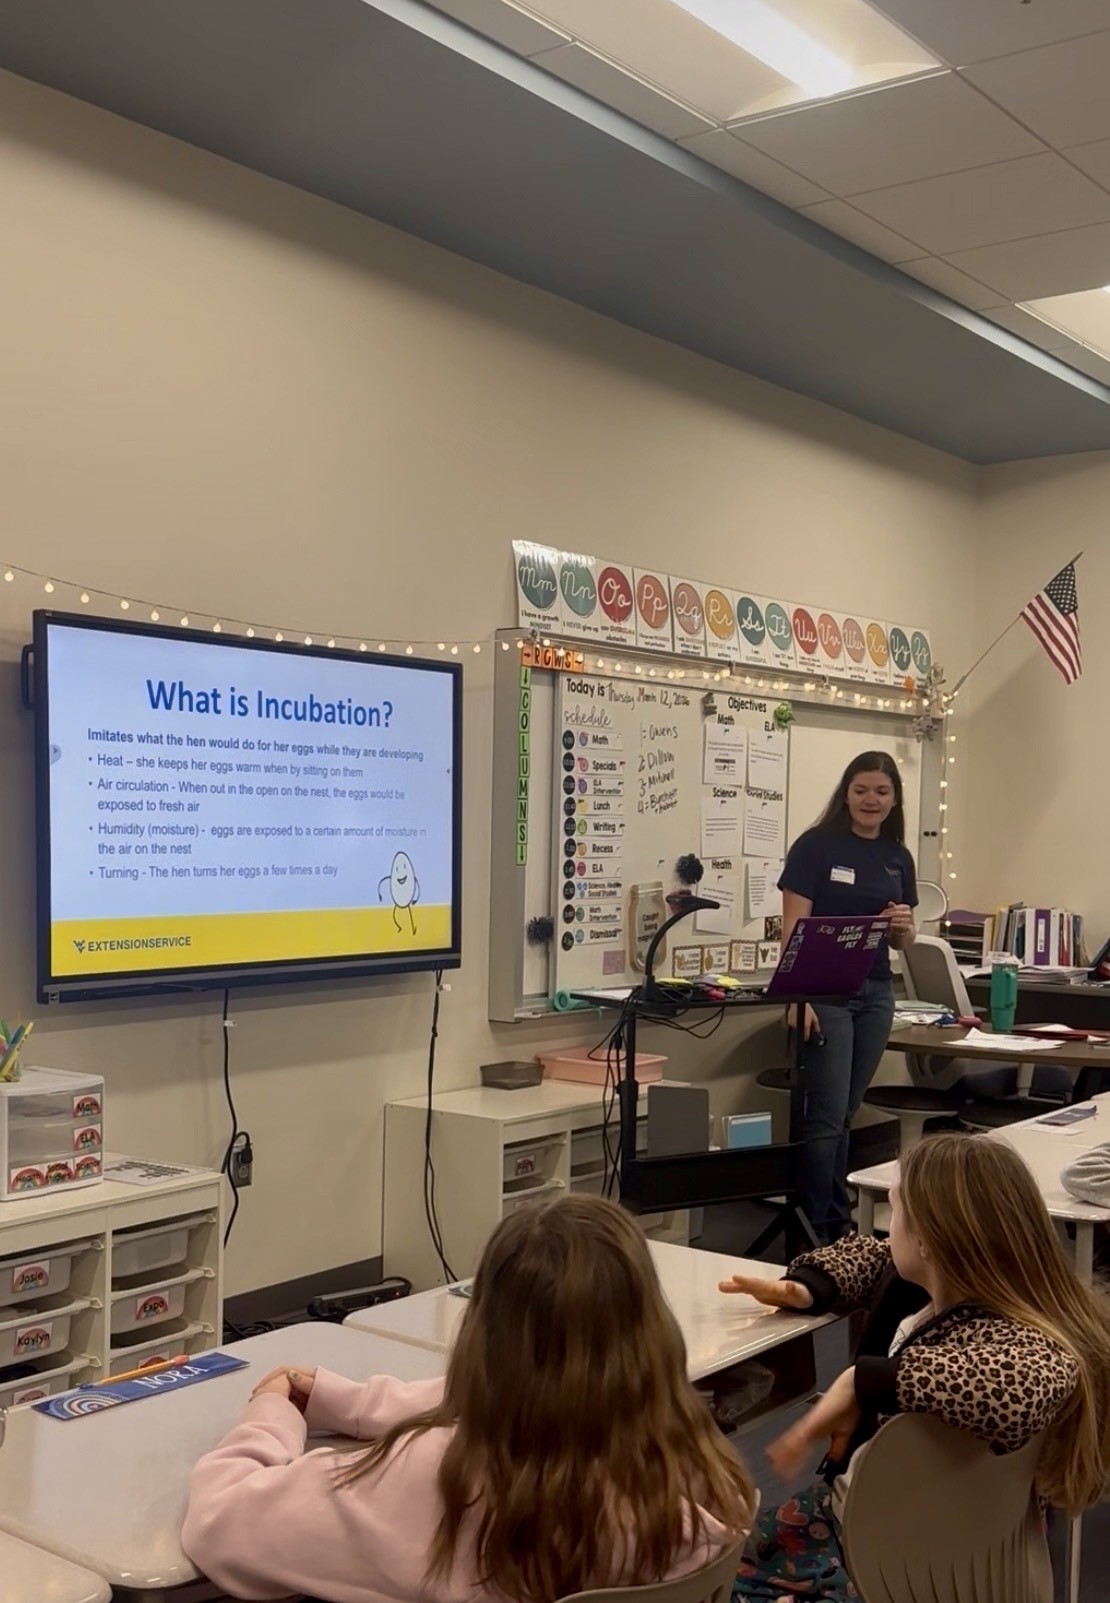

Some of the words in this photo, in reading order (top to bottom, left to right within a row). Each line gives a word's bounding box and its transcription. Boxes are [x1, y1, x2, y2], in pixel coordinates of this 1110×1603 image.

[520, 565, 557, 592] Mm
[562, 571, 596, 600] Nn
[601, 578, 632, 607] Oo
[641, 584, 667, 623] Pp
[675, 591, 702, 630] Qq
[709, 598, 733, 626] Rr
[741, 606, 764, 631] Ss
[769, 614, 790, 638] Tt
[796, 619, 817, 643] Uu
[820, 623, 841, 646] Vv
[844, 629, 865, 650] Ww
[868, 633, 887, 653] Xx
[891, 634, 910, 663] Yy
[914, 637, 930, 665] Zz
[146, 679, 221, 715] What
[230, 686, 249, 717] is
[257, 690, 393, 728] Incubation?
[566, 678, 595, 698] Today
[598, 683, 605, 696] is
[660, 690, 672, 709] 12,
[564, 704, 612, 725] schedule
[728, 697, 767, 713] Objectives
[717, 714, 735, 726] Math
[764, 721, 775, 732] ELA
[88, 728, 133, 743] Imitates
[137, 733, 164, 745] what
[166, 734, 183, 746] the
[186, 734, 206, 747] hen
[209, 738, 240, 749] would
[242, 739, 254, 750] do
[257, 739, 271, 751] for
[274, 741, 289, 752] her
[292, 744, 314, 756] eggs
[317, 744, 340, 755] while
[342, 746, 361, 759] they
[363, 748, 377, 757] are
[379, 748, 424, 762] developing
[592, 734, 609, 745] Math
[97, 753, 123, 767] Heat
[136, 756, 155, 768] she
[158, 757, 189, 771] keeps
[191, 758, 207, 770] her
[209, 761, 233, 774] eggs
[236, 763, 261, 773] warm
[264, 764, 288, 774] when
[290, 764, 300, 777] by
[303, 765, 328, 778] sitting
[330, 768, 341, 777] on
[343, 766, 363, 777] them
[519, 692, 529, 841] COLUMNS
[592, 760, 617, 771] Specials
[647, 749, 675, 769] Dillon
[97, 778, 113, 790] Air
[116, 780, 169, 792] circulation
[178, 781, 207, 793] When
[210, 785, 225, 794] out
[228, 784, 237, 795] in
[239, 784, 253, 795] the
[256, 786, 279, 797] open
[281, 787, 292, 796] on
[294, 785, 308, 796] the
[333, 787, 347, 798] the
[348, 789, 368, 801] eggs
[370, 788, 393, 799] would
[394, 789, 405, 800] be
[713, 787, 737, 798] Science
[764, 790, 783, 801] Studies
[97, 799, 143, 813] exposed
[146, 801, 157, 811] to
[159, 800, 185, 811] fresh
[187, 801, 200, 812] air
[593, 801, 610, 810] Lunch
[98, 822, 145, 837] Humidity
[147, 823, 199, 837] (moisture)
[211, 825, 234, 838] eggs
[236, 826, 252, 835] are
[254, 826, 293, 838] exposed
[294, 826, 303, 836] to
[305, 827, 311, 836] a
[313, 826, 342, 836] certain
[343, 827, 373, 837] amount
[375, 826, 384, 837] of
[385, 826, 418, 837] moisture
[592, 822, 616, 833] Writing
[98, 843, 115, 854] the
[118, 843, 132, 854] air
[134, 845, 148, 854] on
[151, 843, 167, 854] the
[170, 843, 192, 854] nest
[592, 843, 613, 853] Recess
[98, 866, 139, 880] Turning
[149, 866, 169, 878] The
[171, 866, 190, 878] hen
[193, 866, 217, 877] turns
[220, 866, 236, 877] her
[238, 867, 261, 878] eggs
[263, 868, 269, 876] a
[271, 864, 287, 876] few
[289, 865, 313, 875] times
[314, 867, 320, 875] a
[322, 864, 338, 877] day
[592, 864, 603, 873] ELA
[712, 859, 732, 870] Health
[88, 936, 191, 952] EXTENSIONSERVICE
[590, 929, 617, 939] Dismissal
[19, 1270, 44, 1285] Josie
[143, 1300, 164, 1314] Expo
[17, 1331, 50, 1347] Kaylyn
[132, 1365, 210, 1389] NORA
